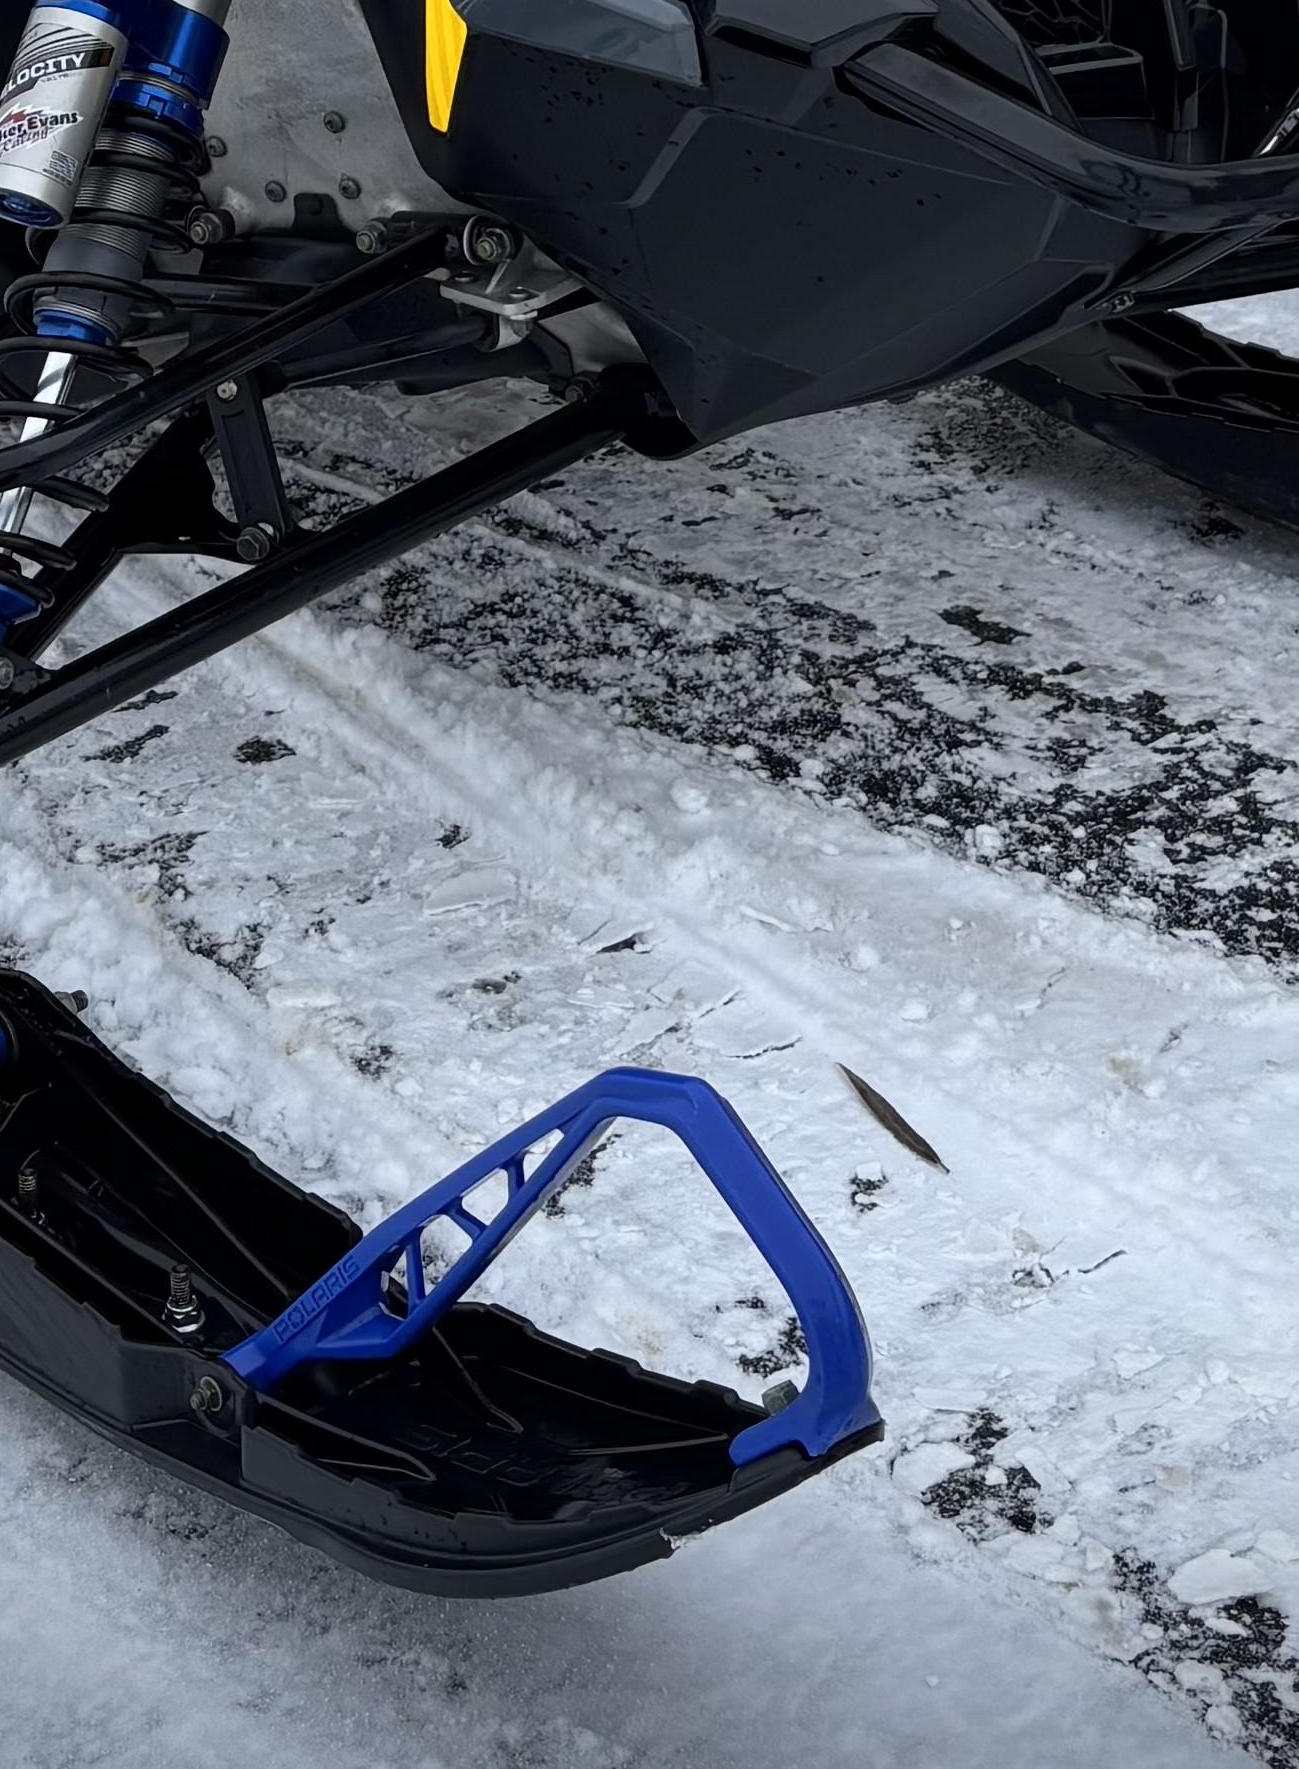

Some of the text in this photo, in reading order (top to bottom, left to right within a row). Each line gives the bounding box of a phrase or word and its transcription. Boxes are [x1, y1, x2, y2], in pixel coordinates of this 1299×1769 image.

[3, 52, 85, 94] LOCITY
[26, 112, 79, 130] Evans
[273, 1254, 359, 1342] POLARIS
